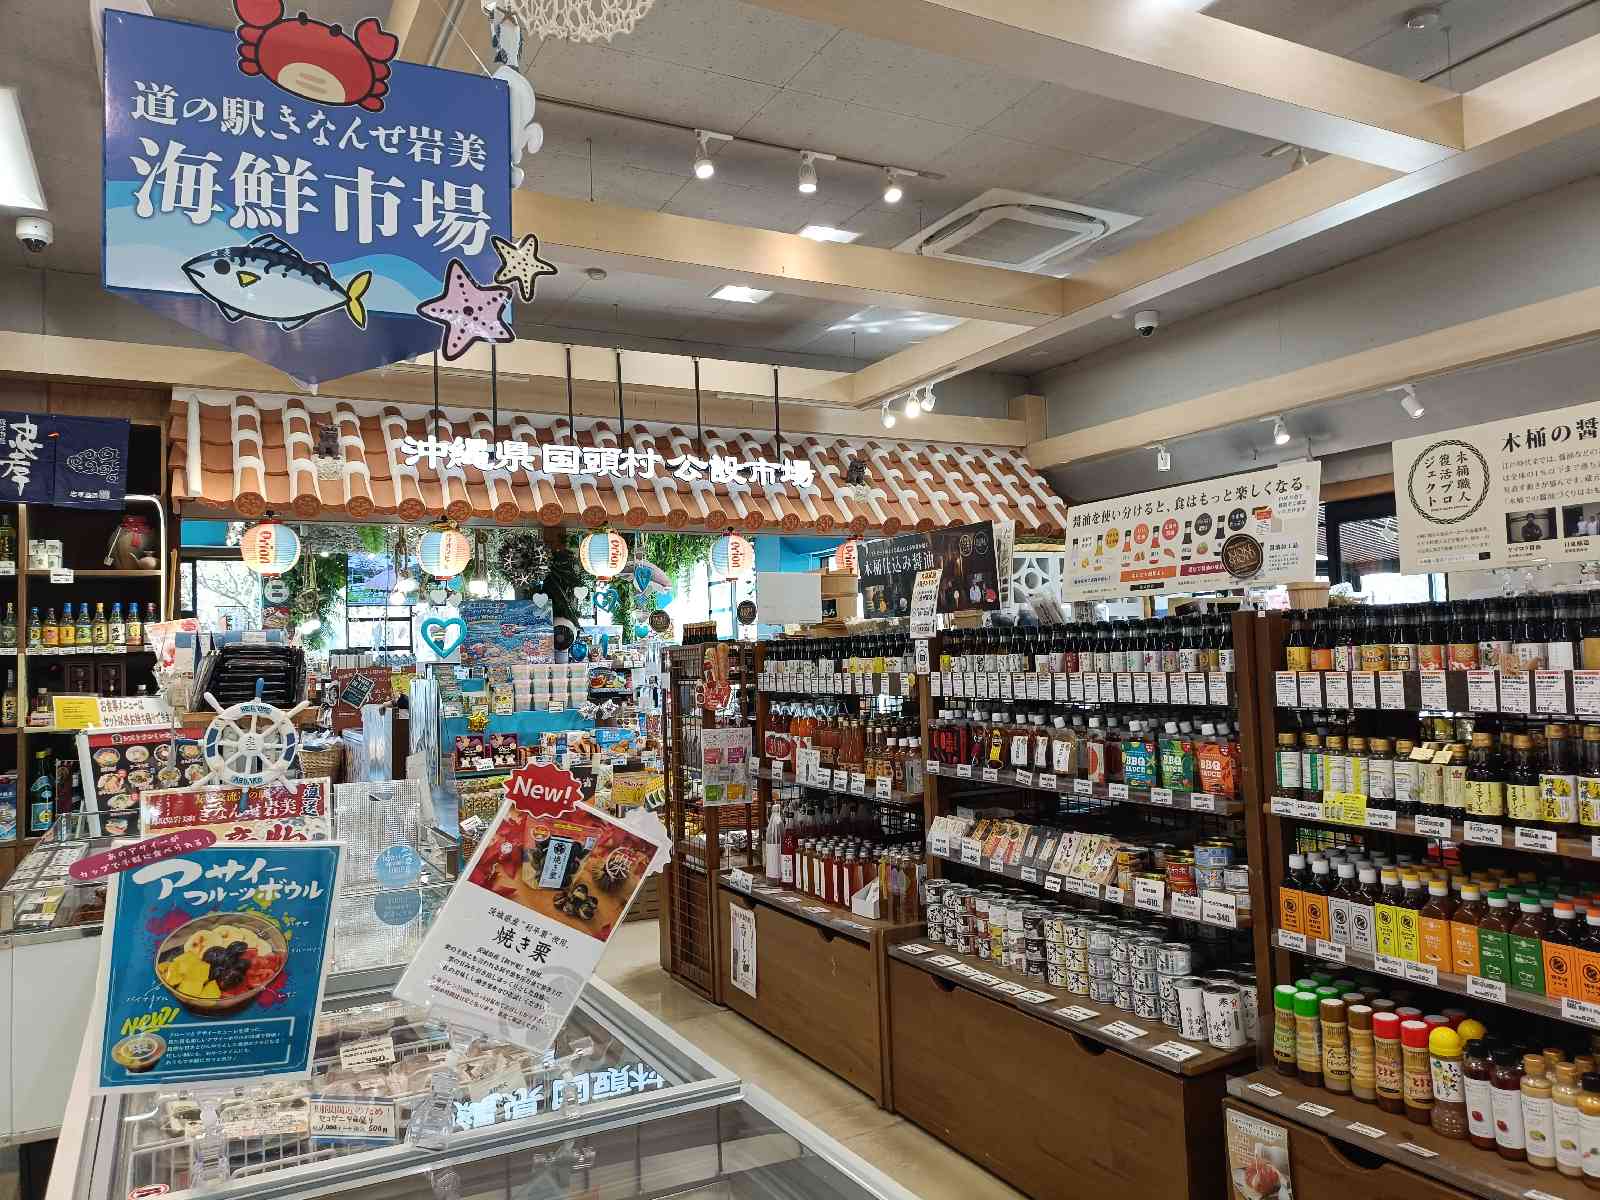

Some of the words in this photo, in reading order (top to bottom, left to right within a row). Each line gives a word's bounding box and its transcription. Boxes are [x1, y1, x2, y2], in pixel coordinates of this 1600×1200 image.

[131, 80, 487, 172] 道の駅きなんせ岩美
[129, 137, 492, 256] 海鮮市場
[1072, 476, 1303, 529] 醤油を使い分けると、食はもっと楽しくなる
[512, 775, 573, 805] New!
[131, 857, 288, 901] アサイー
[183, 877, 325, 906] フルーツボウル
[492, 925, 552, 964] 焼き栗
